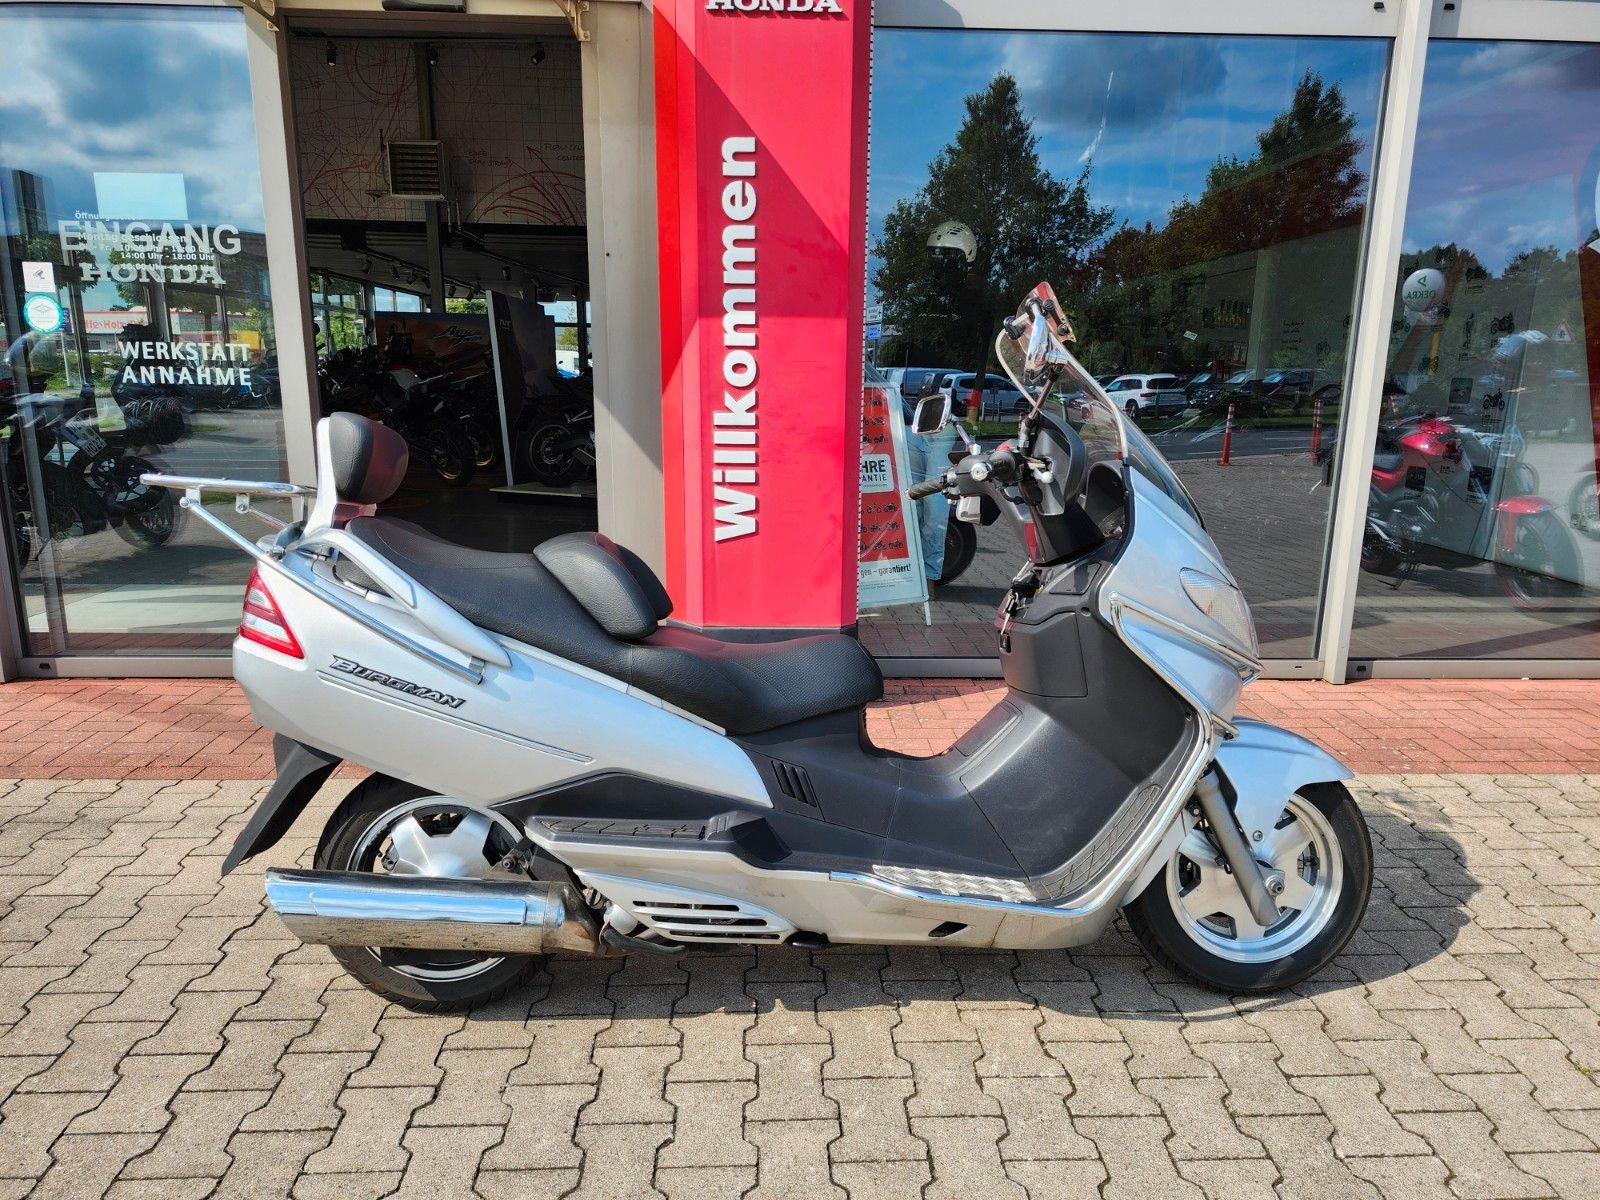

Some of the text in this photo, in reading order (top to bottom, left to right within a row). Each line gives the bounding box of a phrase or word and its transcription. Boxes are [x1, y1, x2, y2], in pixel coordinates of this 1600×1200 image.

[705, 0, 842, 13] HONDA
[57, 219, 242, 256] EINGANG
[120, 252, 144, 260] 14:00
[147, 252, 163, 260] Uhr
[172, 253, 197, 261] 18:00
[199, 253, 215, 261] Uhr
[79, 262, 226, 285] HONDA
[713, 136, 757, 542] Willkommen
[118, 341, 251, 363] WERKSTATT
[122, 366, 252, 386] ANNAHME
[861, 459, 887, 473] HRE
[861, 473, 888, 482] ANTIE
[860, 569, 872, 578] gen
[329, 654, 467, 709] BURGMAN
